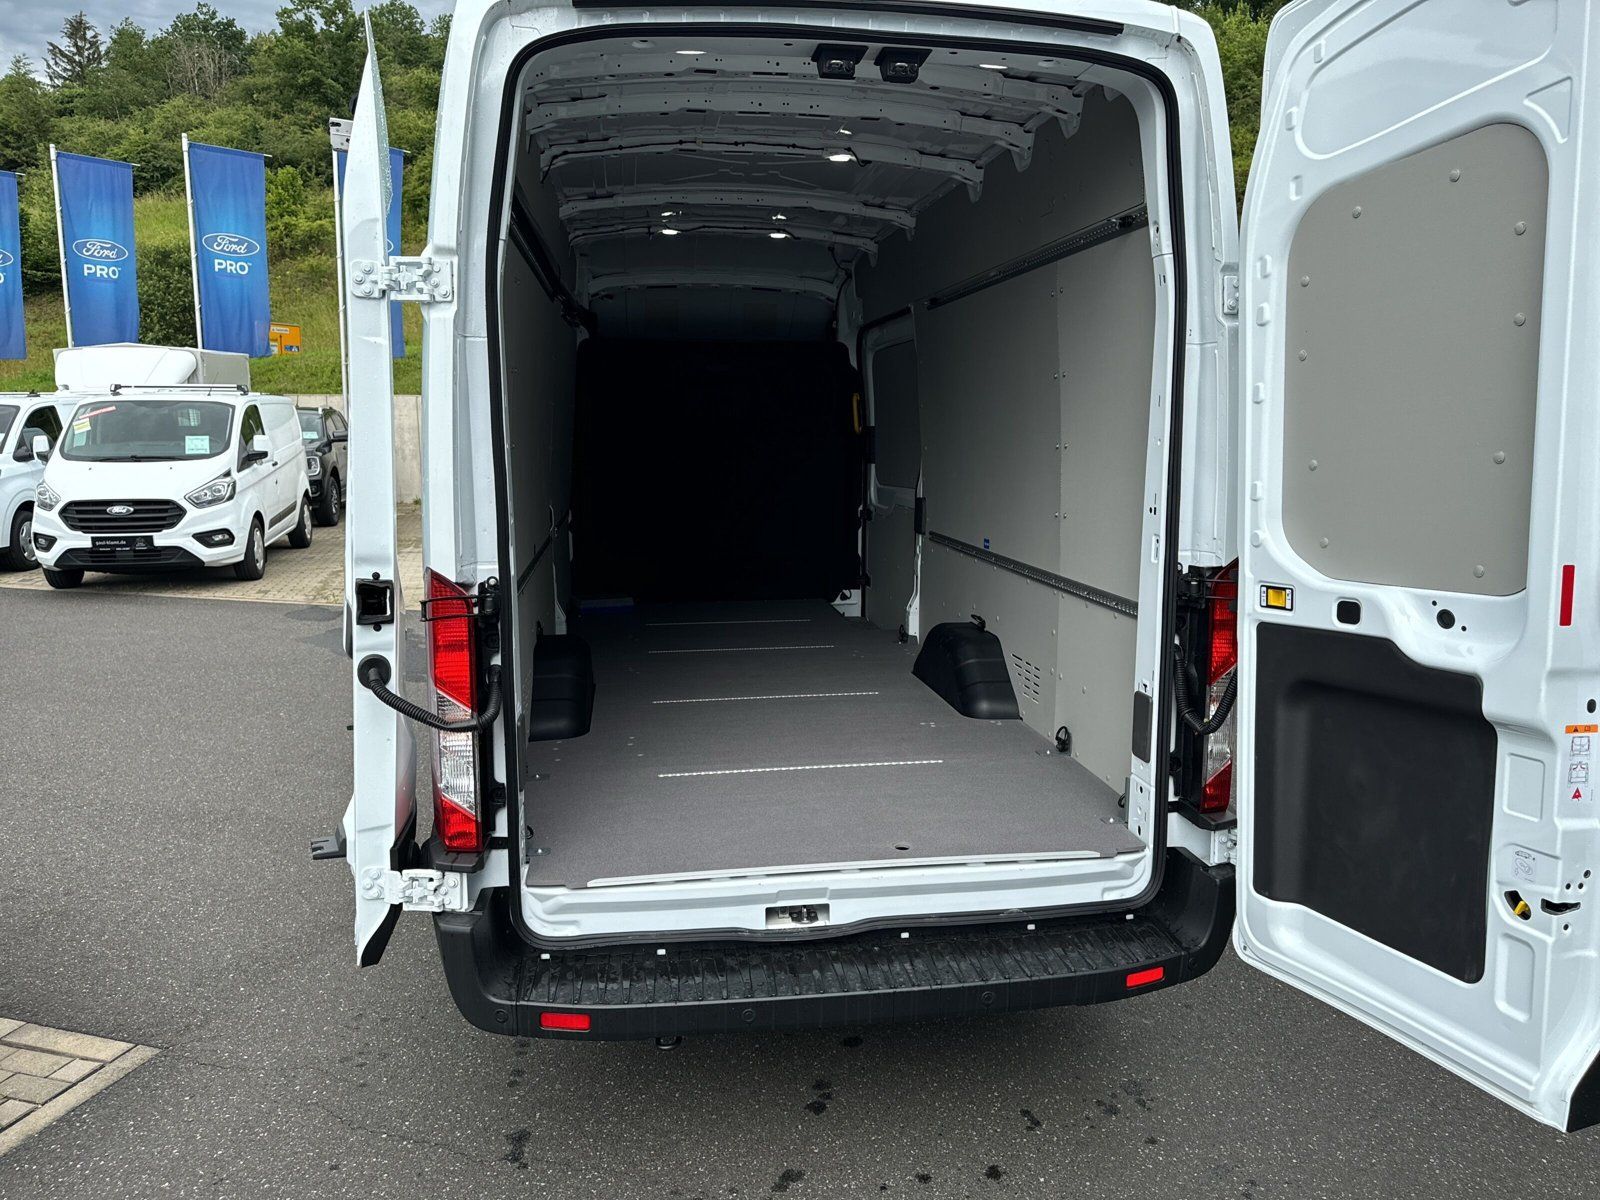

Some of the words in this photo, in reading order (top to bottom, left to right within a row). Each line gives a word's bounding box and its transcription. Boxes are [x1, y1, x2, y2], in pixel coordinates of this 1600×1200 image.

[82, 241, 118, 259] Ford
[213, 235, 249, 254] Ford
[83, 263, 119, 279] PRO
[214, 258, 249, 275] PRO
